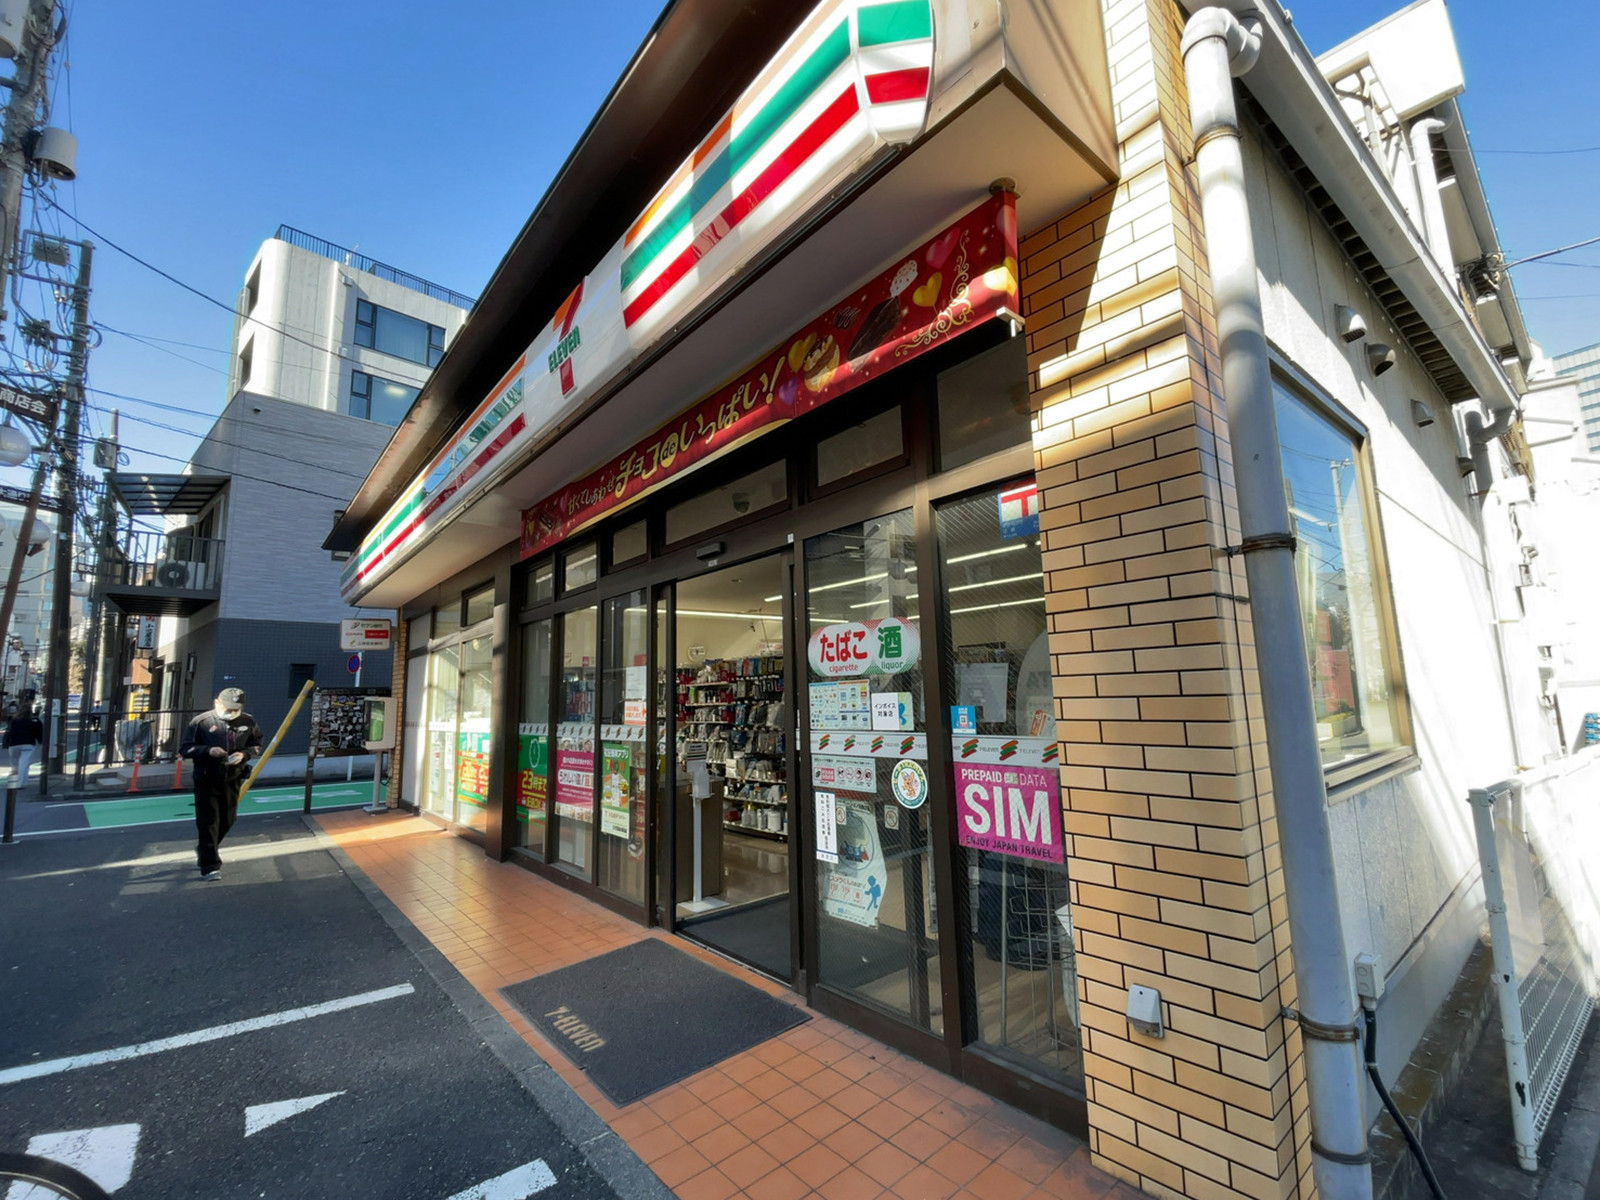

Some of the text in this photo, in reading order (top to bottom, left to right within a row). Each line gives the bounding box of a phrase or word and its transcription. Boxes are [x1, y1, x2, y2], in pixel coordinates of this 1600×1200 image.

[820, 625, 902, 663] たばこ 酒
[829, 660, 904, 673] cigarette liquor
[961, 768, 1048, 788] PREPAID DATA
[964, 783, 1052, 845] SIM
[966, 835, 1054, 859] ENJOY JAPAN TRAVEL
